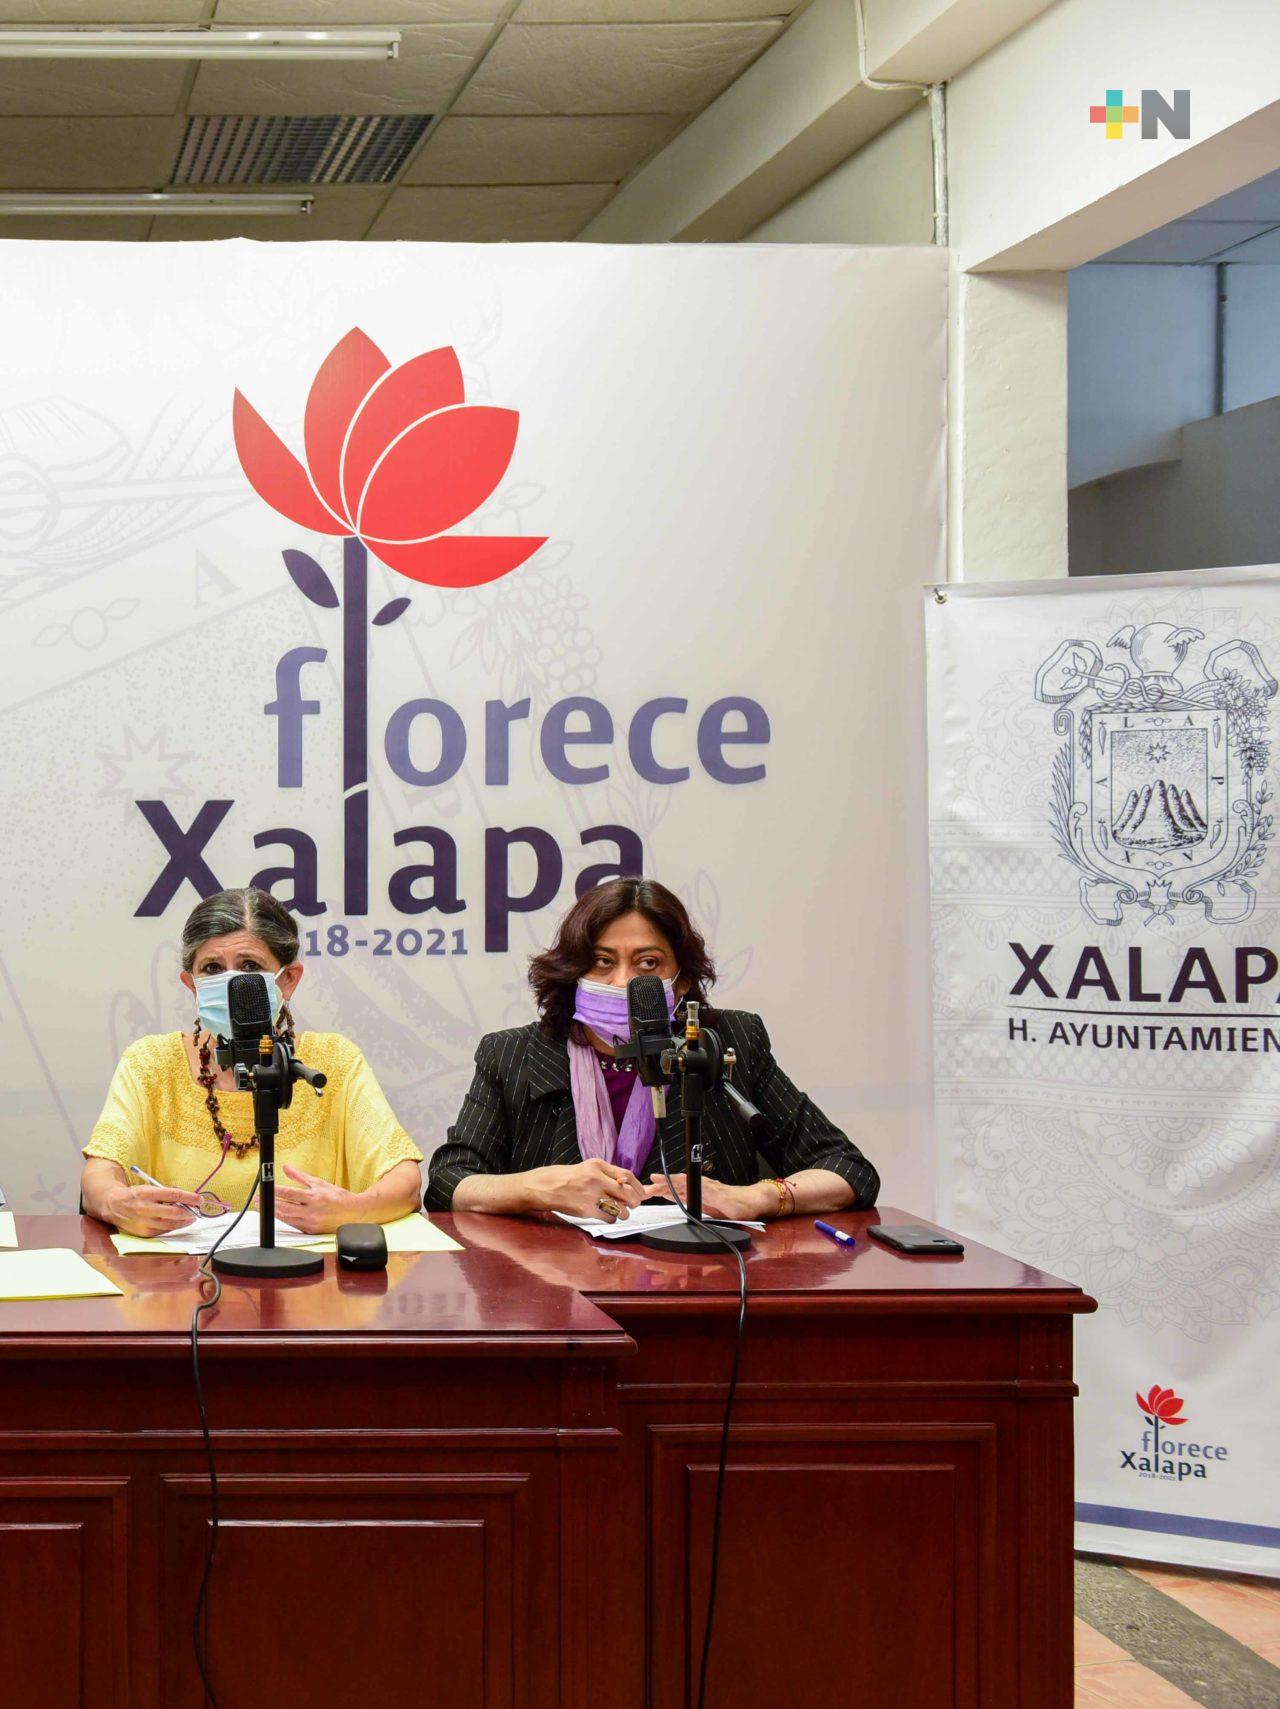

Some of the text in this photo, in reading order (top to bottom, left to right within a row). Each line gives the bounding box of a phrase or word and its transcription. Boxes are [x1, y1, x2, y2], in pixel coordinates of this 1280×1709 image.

[264, 646, 771, 788] florece
[305, 924, 468, 957] 18-2021
[1008, 942, 1280, 1004] XALAP
[1008, 1018, 1037, 1044] H.
[1141, 1430, 1228, 1461] florece
[1120, 1450, 1207, 1481] Xalapa
